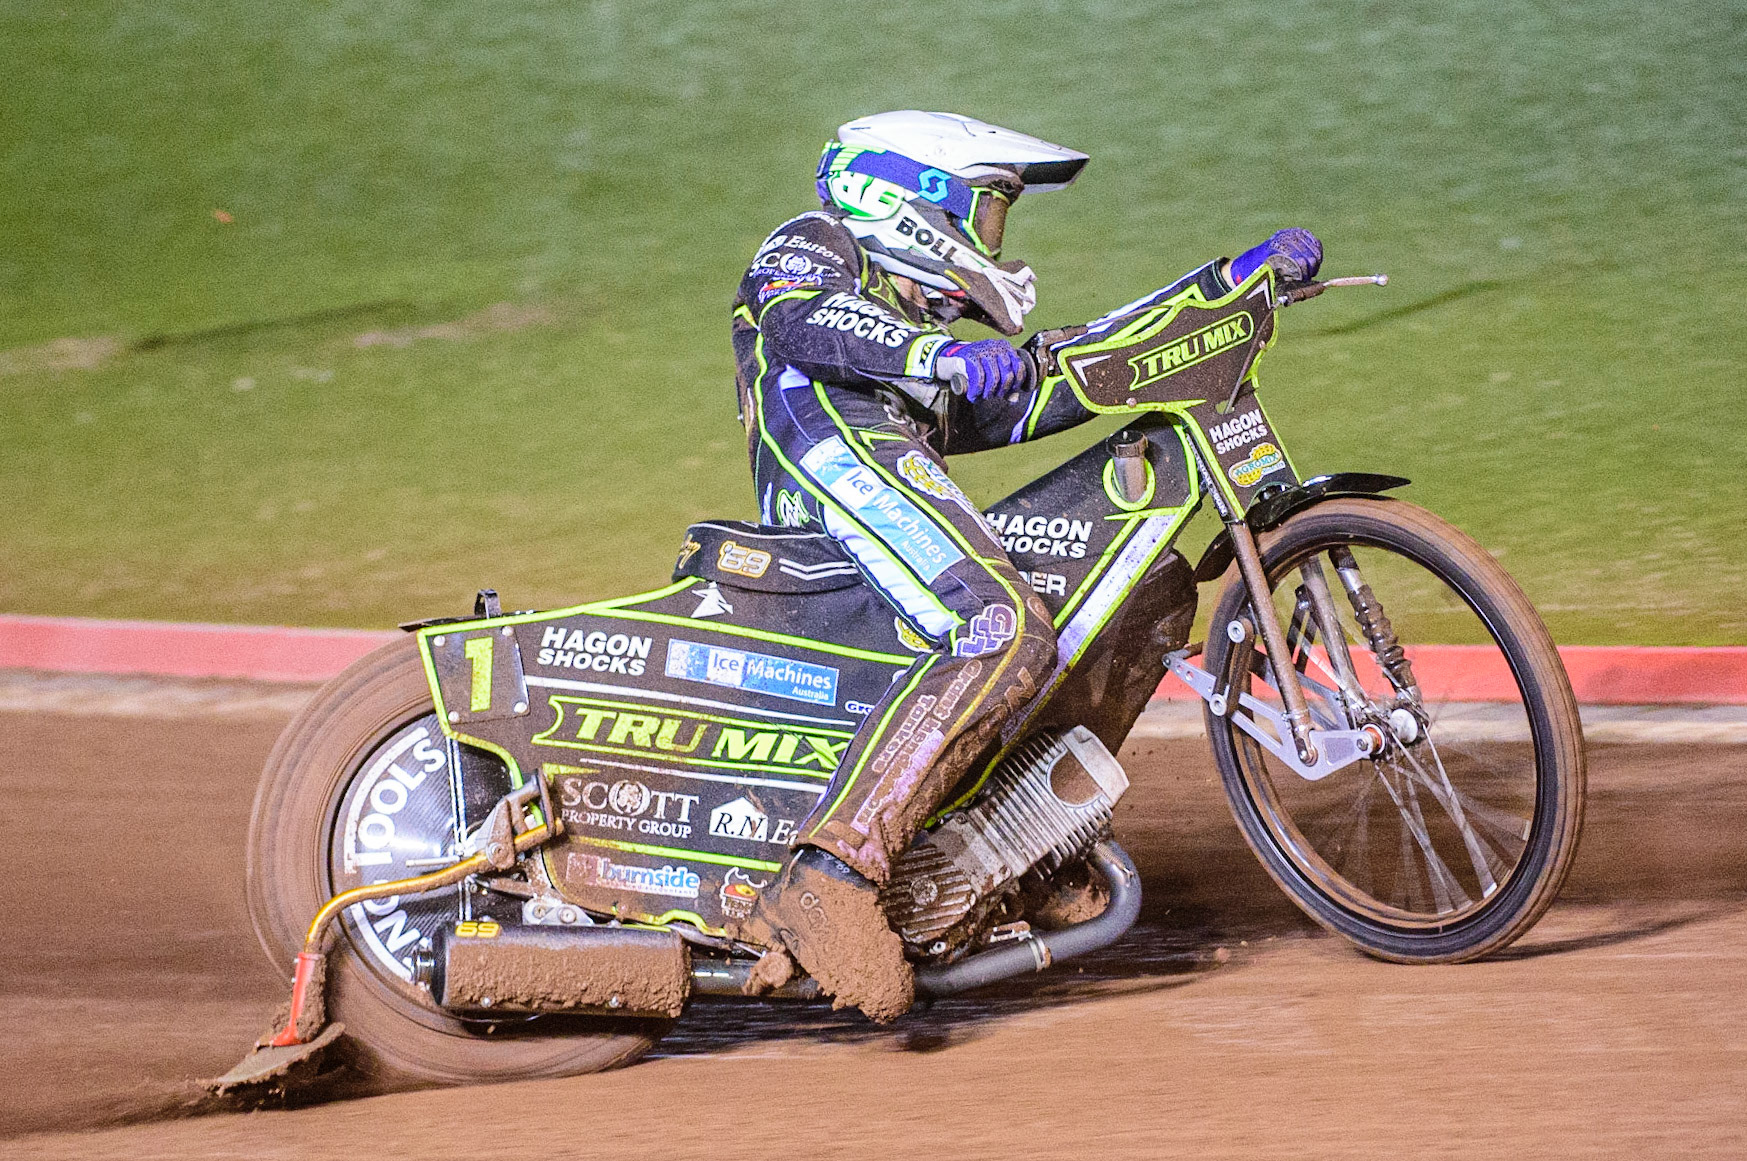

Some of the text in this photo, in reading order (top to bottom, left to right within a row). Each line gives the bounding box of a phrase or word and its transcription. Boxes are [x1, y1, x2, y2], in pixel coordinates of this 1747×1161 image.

[785, 235, 845, 265] Euston
[806, 308, 909, 348] SHOCKS
[1142, 316, 1248, 378] TRU MIX
[1209, 409, 1263, 443] HAGON
[1216, 424, 1268, 455] SHOCKS
[1234, 452, 1280, 477] AGROMIX
[847, 470, 874, 496] Ice
[873, 493, 948, 564] Machines
[986, 512, 1093, 542] HAGON
[901, 540, 931, 571] Australia
[999, 536, 1087, 559] HOCKS
[540, 626, 652, 659] HAGON
[464, 636, 494, 713] 1
[537, 648, 647, 676] SHOCKS
[712, 652, 833, 690] Ice Machines
[792, 685, 831, 701] Australia
[575, 708, 850, 770] TRU MIX
[561, 776, 700, 823] SCOTT
[561, 807, 692, 839] PROPERTY GROUP
[601, 858, 699, 889] burnside
[455, 922, 500, 938] 69
